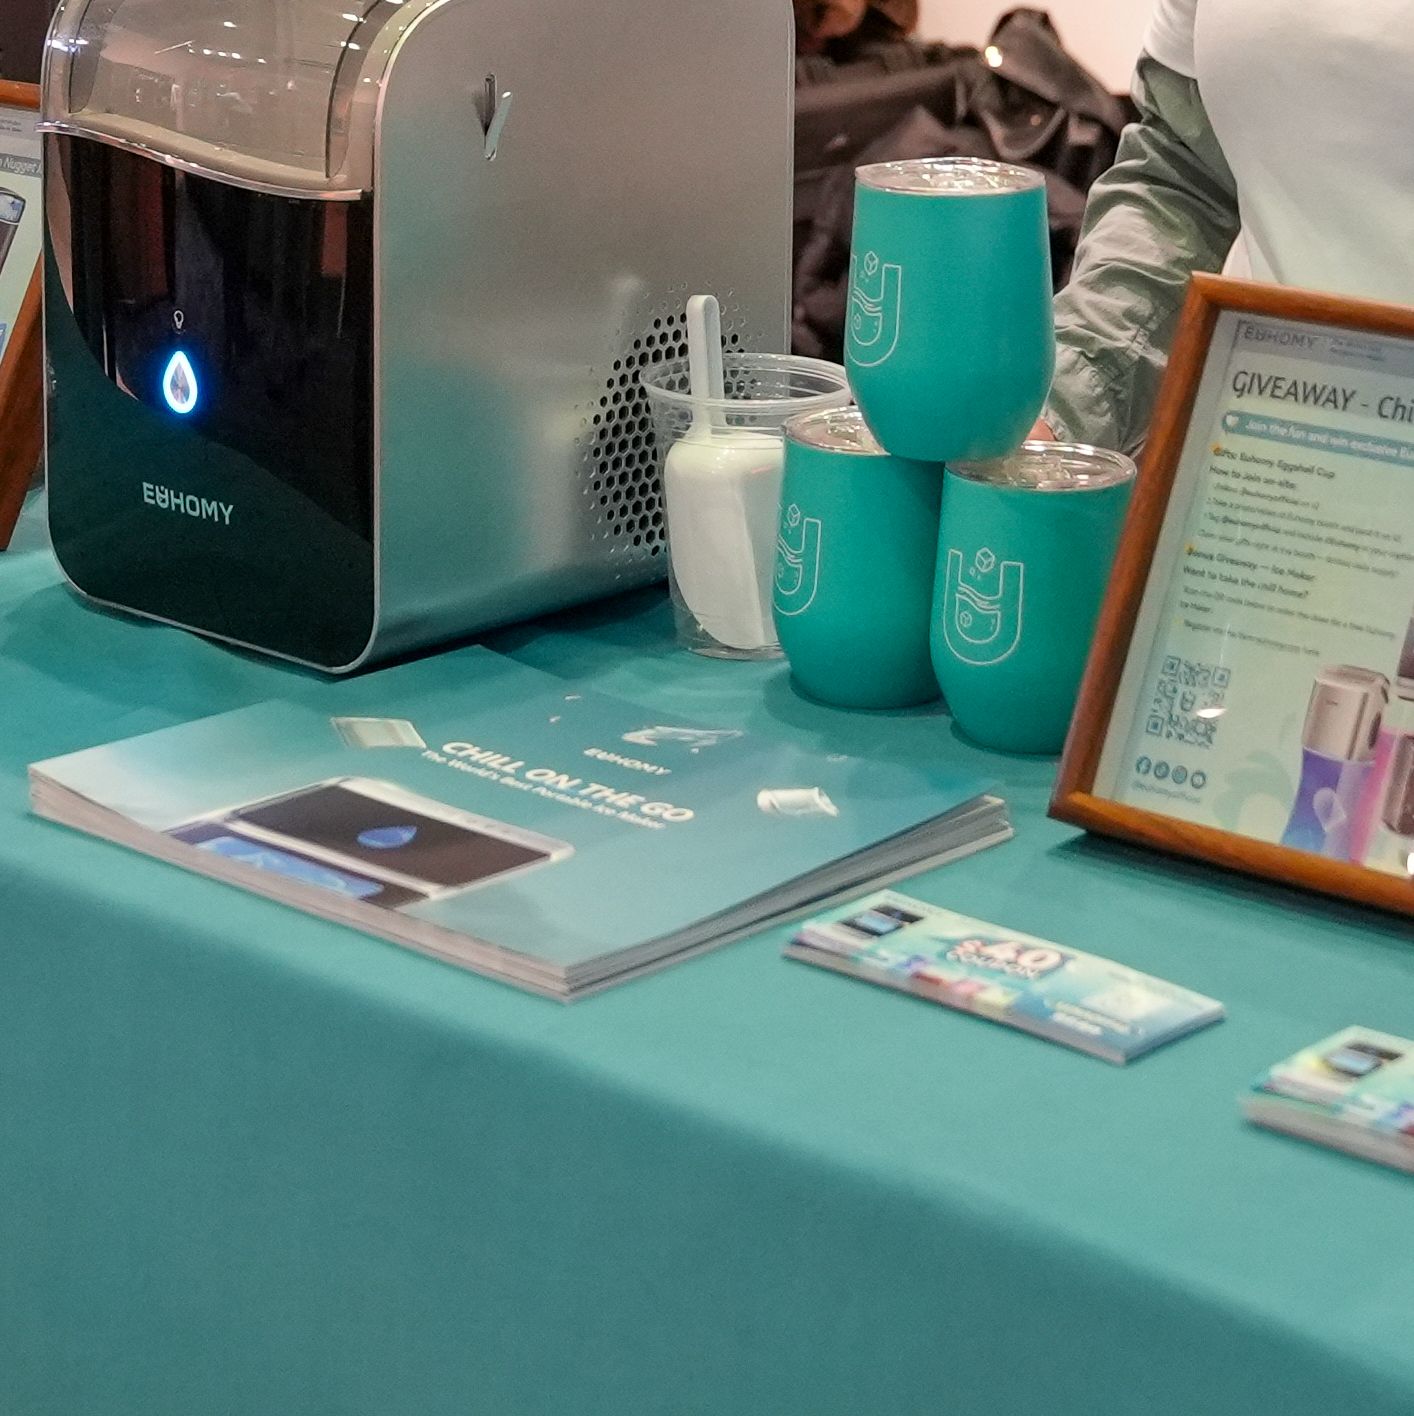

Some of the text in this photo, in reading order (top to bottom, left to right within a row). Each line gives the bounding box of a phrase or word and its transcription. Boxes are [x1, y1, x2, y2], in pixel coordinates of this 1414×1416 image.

[1232, 371, 1356, 412] GIVEAWAY
[142, 480, 235, 526] EUHOMY
[442, 741, 695, 823] CHILL ON THE GO
